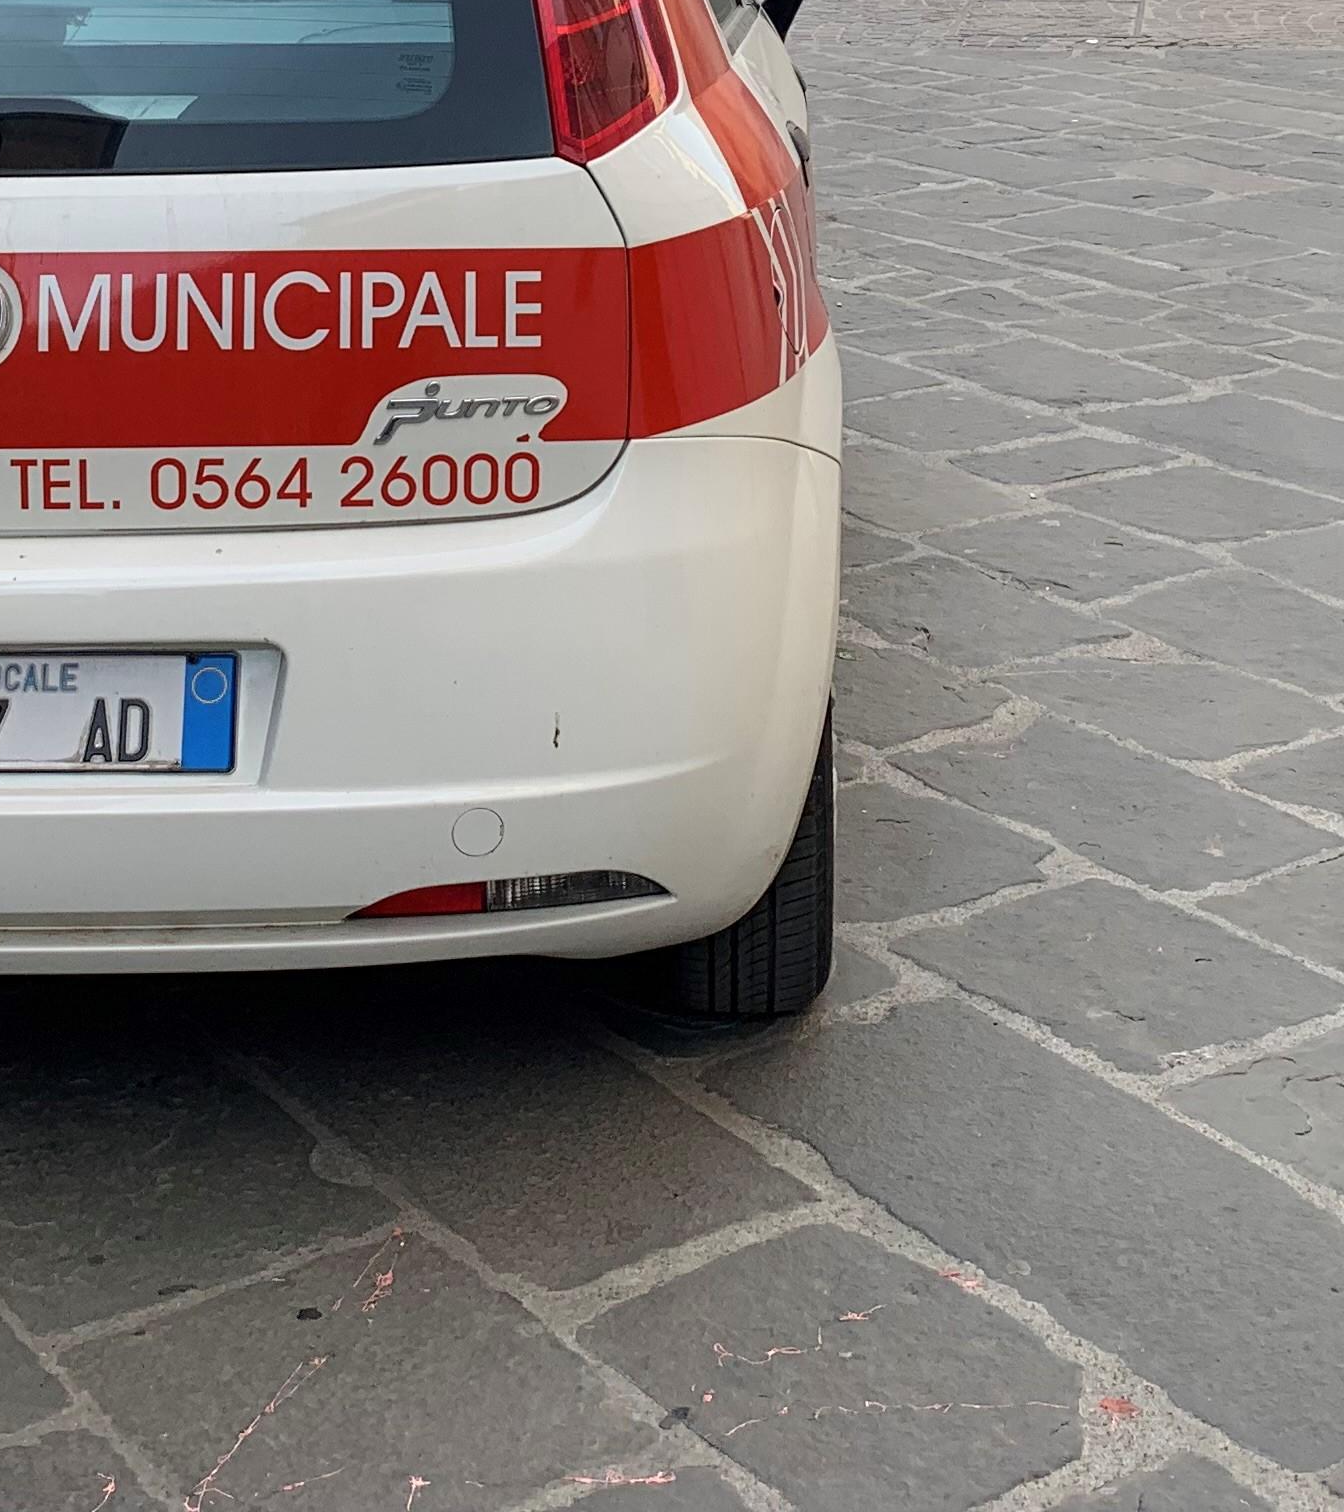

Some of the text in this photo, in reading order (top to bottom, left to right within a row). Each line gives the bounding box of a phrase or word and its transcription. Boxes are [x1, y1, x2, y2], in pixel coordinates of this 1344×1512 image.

[36, 270, 543, 353] MUNICIPALE
[9, 452, 541, 510] TEL. 0564 26000
[81, 698, 151, 763] AD
